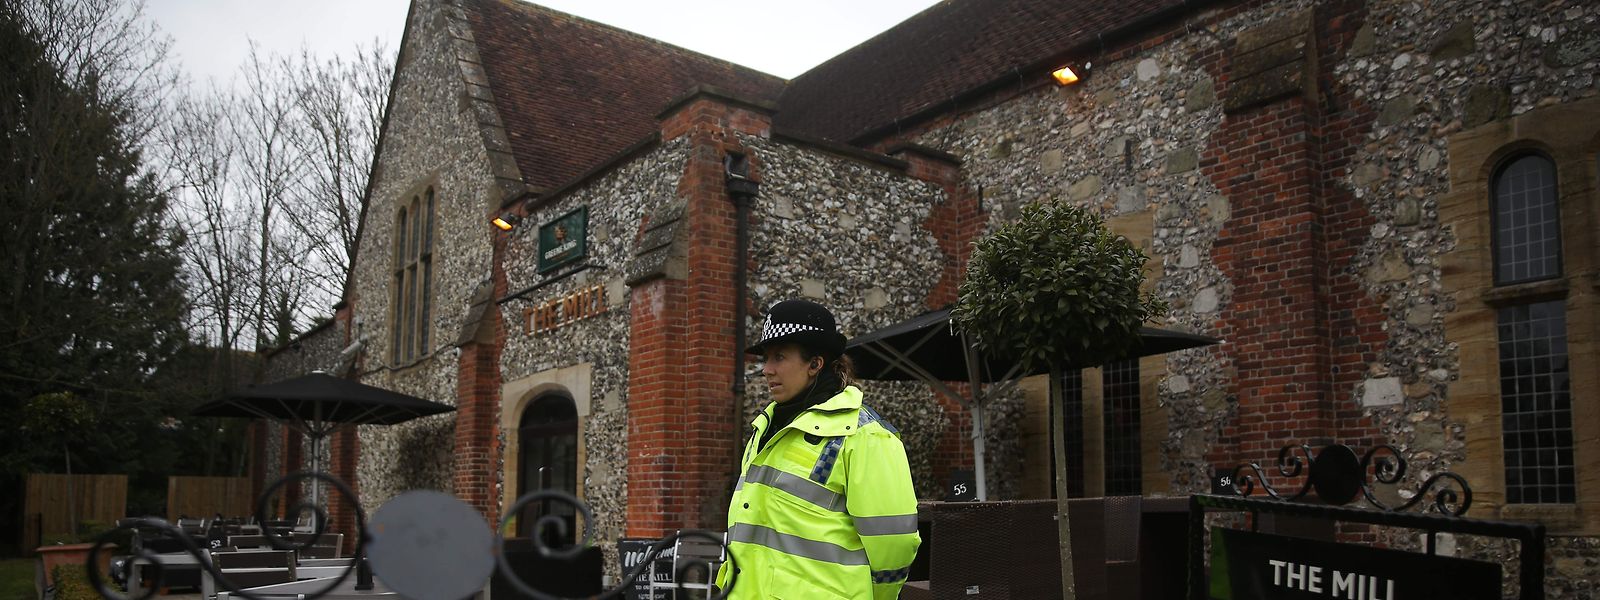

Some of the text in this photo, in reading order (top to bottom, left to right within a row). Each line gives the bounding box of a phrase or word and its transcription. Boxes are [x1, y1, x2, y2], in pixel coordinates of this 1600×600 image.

[523, 284, 608, 336] THE MILL
[953, 483, 967, 496] 55
[210, 539, 221, 549] 52
[1269, 559, 1395, 600] THE MILL
